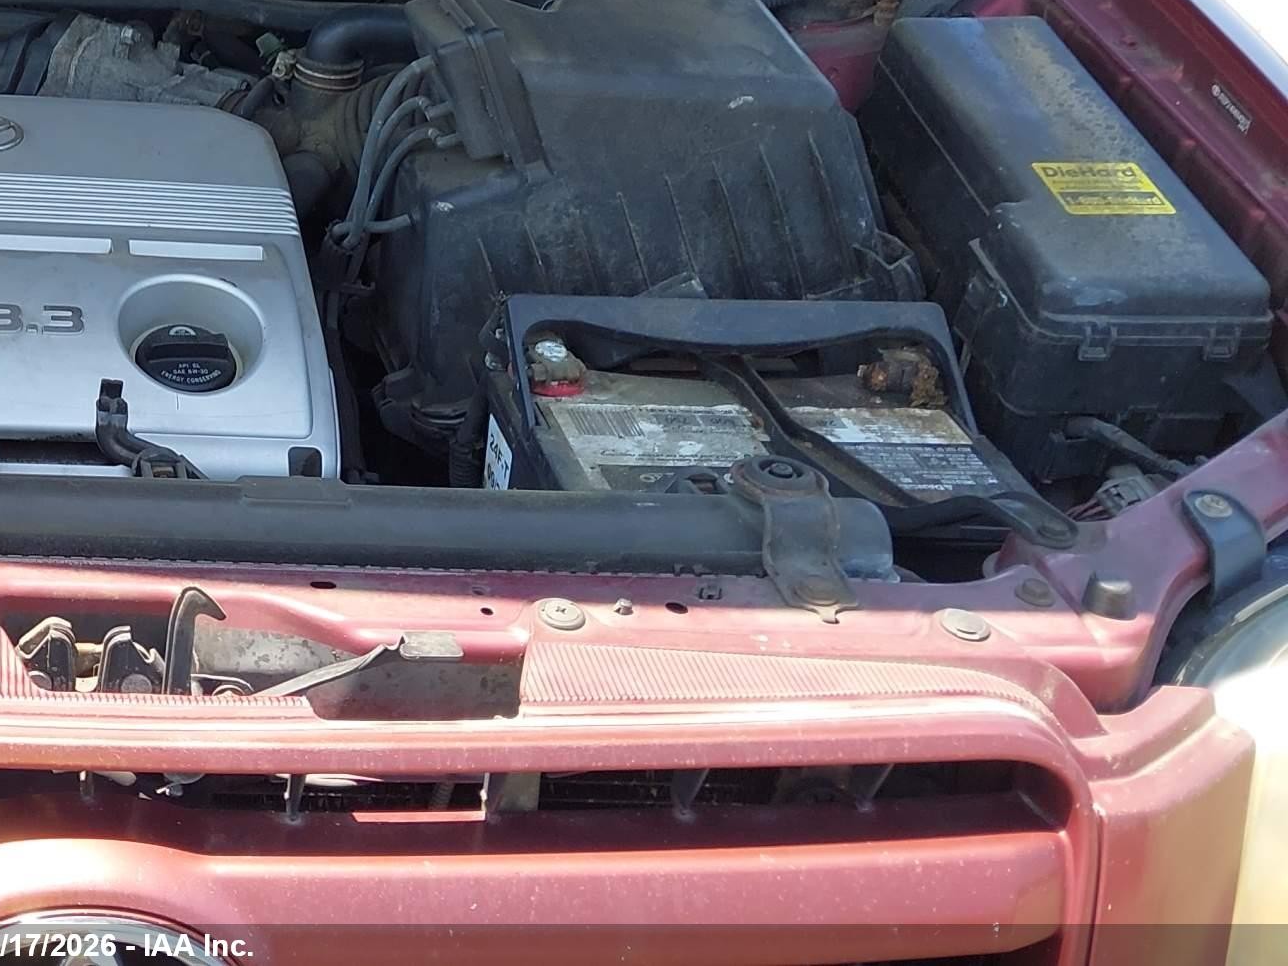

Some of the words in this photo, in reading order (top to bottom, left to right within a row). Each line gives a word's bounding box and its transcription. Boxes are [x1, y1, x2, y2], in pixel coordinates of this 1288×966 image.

[1041, 166, 1138, 177] DieHard
[161, 370, 185, 382] ENERGY
[187, 369, 221, 384] CONSERVING
